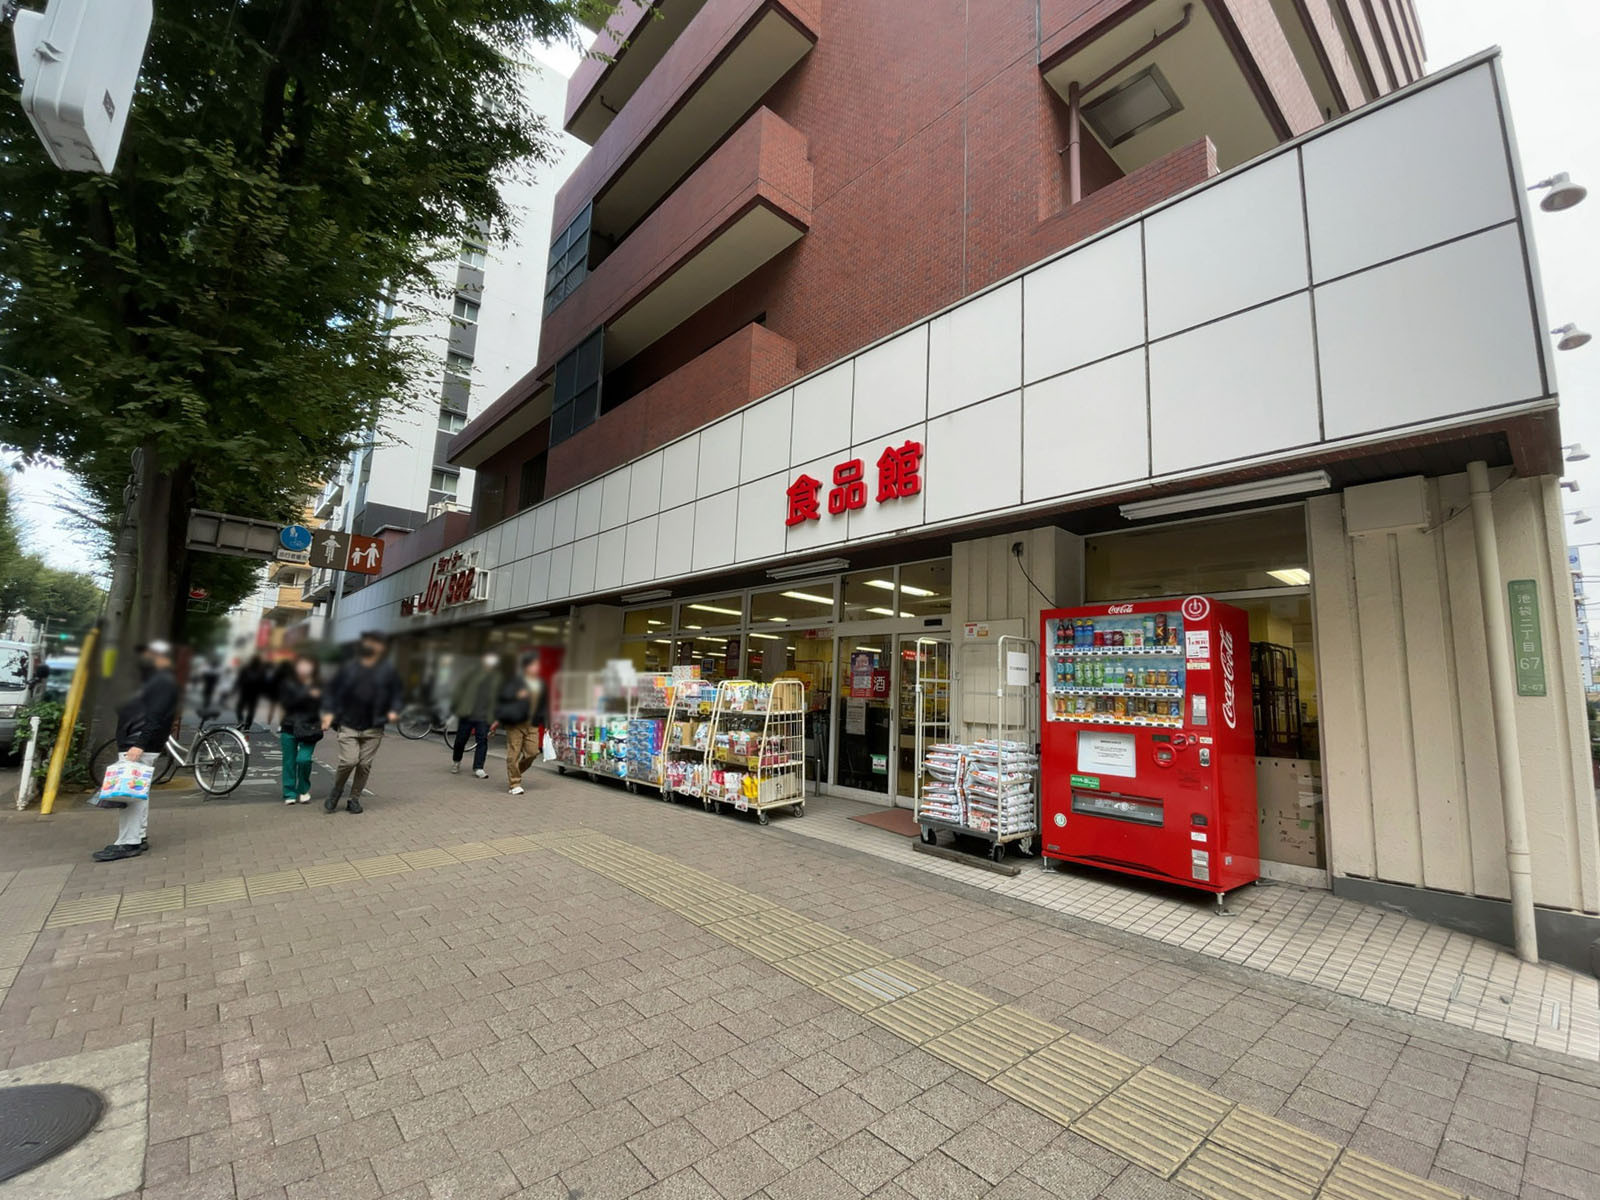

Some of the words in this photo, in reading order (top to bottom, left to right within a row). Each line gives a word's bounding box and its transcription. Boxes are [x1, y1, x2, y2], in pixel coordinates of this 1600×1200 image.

[785, 440, 924, 527] 食品館
[1108, 603, 1134, 614] Coca-Cola
[873, 675, 886, 692] 酒
[1219, 623, 1236, 729] Coca-Cola
